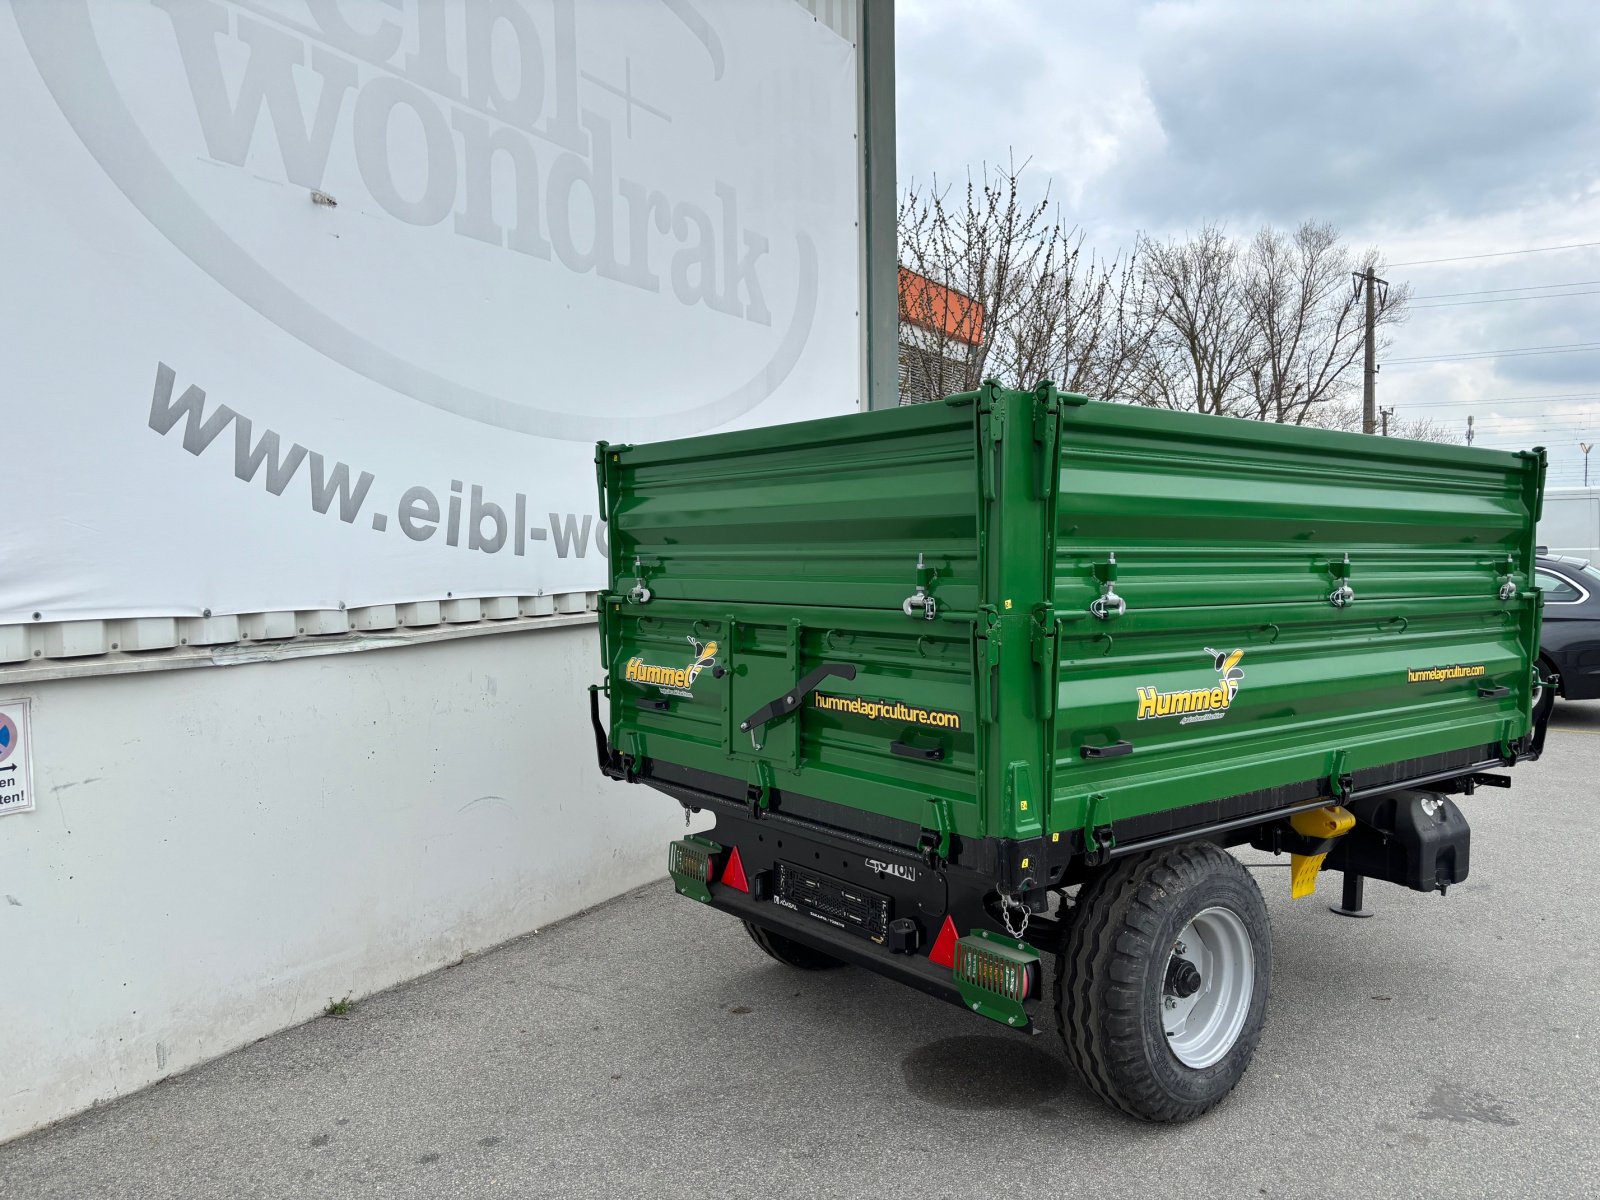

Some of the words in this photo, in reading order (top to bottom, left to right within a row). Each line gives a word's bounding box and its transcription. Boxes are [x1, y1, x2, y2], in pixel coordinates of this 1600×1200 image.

[151, 0, 771, 327] wondrak
[149, 361, 609, 560] www.eibl-w
[626, 657, 693, 690] Hummel
[1408, 665, 1485, 682] hummelagriculture.com
[815, 691, 960, 729] hummelagriculture.com
[1137, 680, 1231, 720] Hummel
